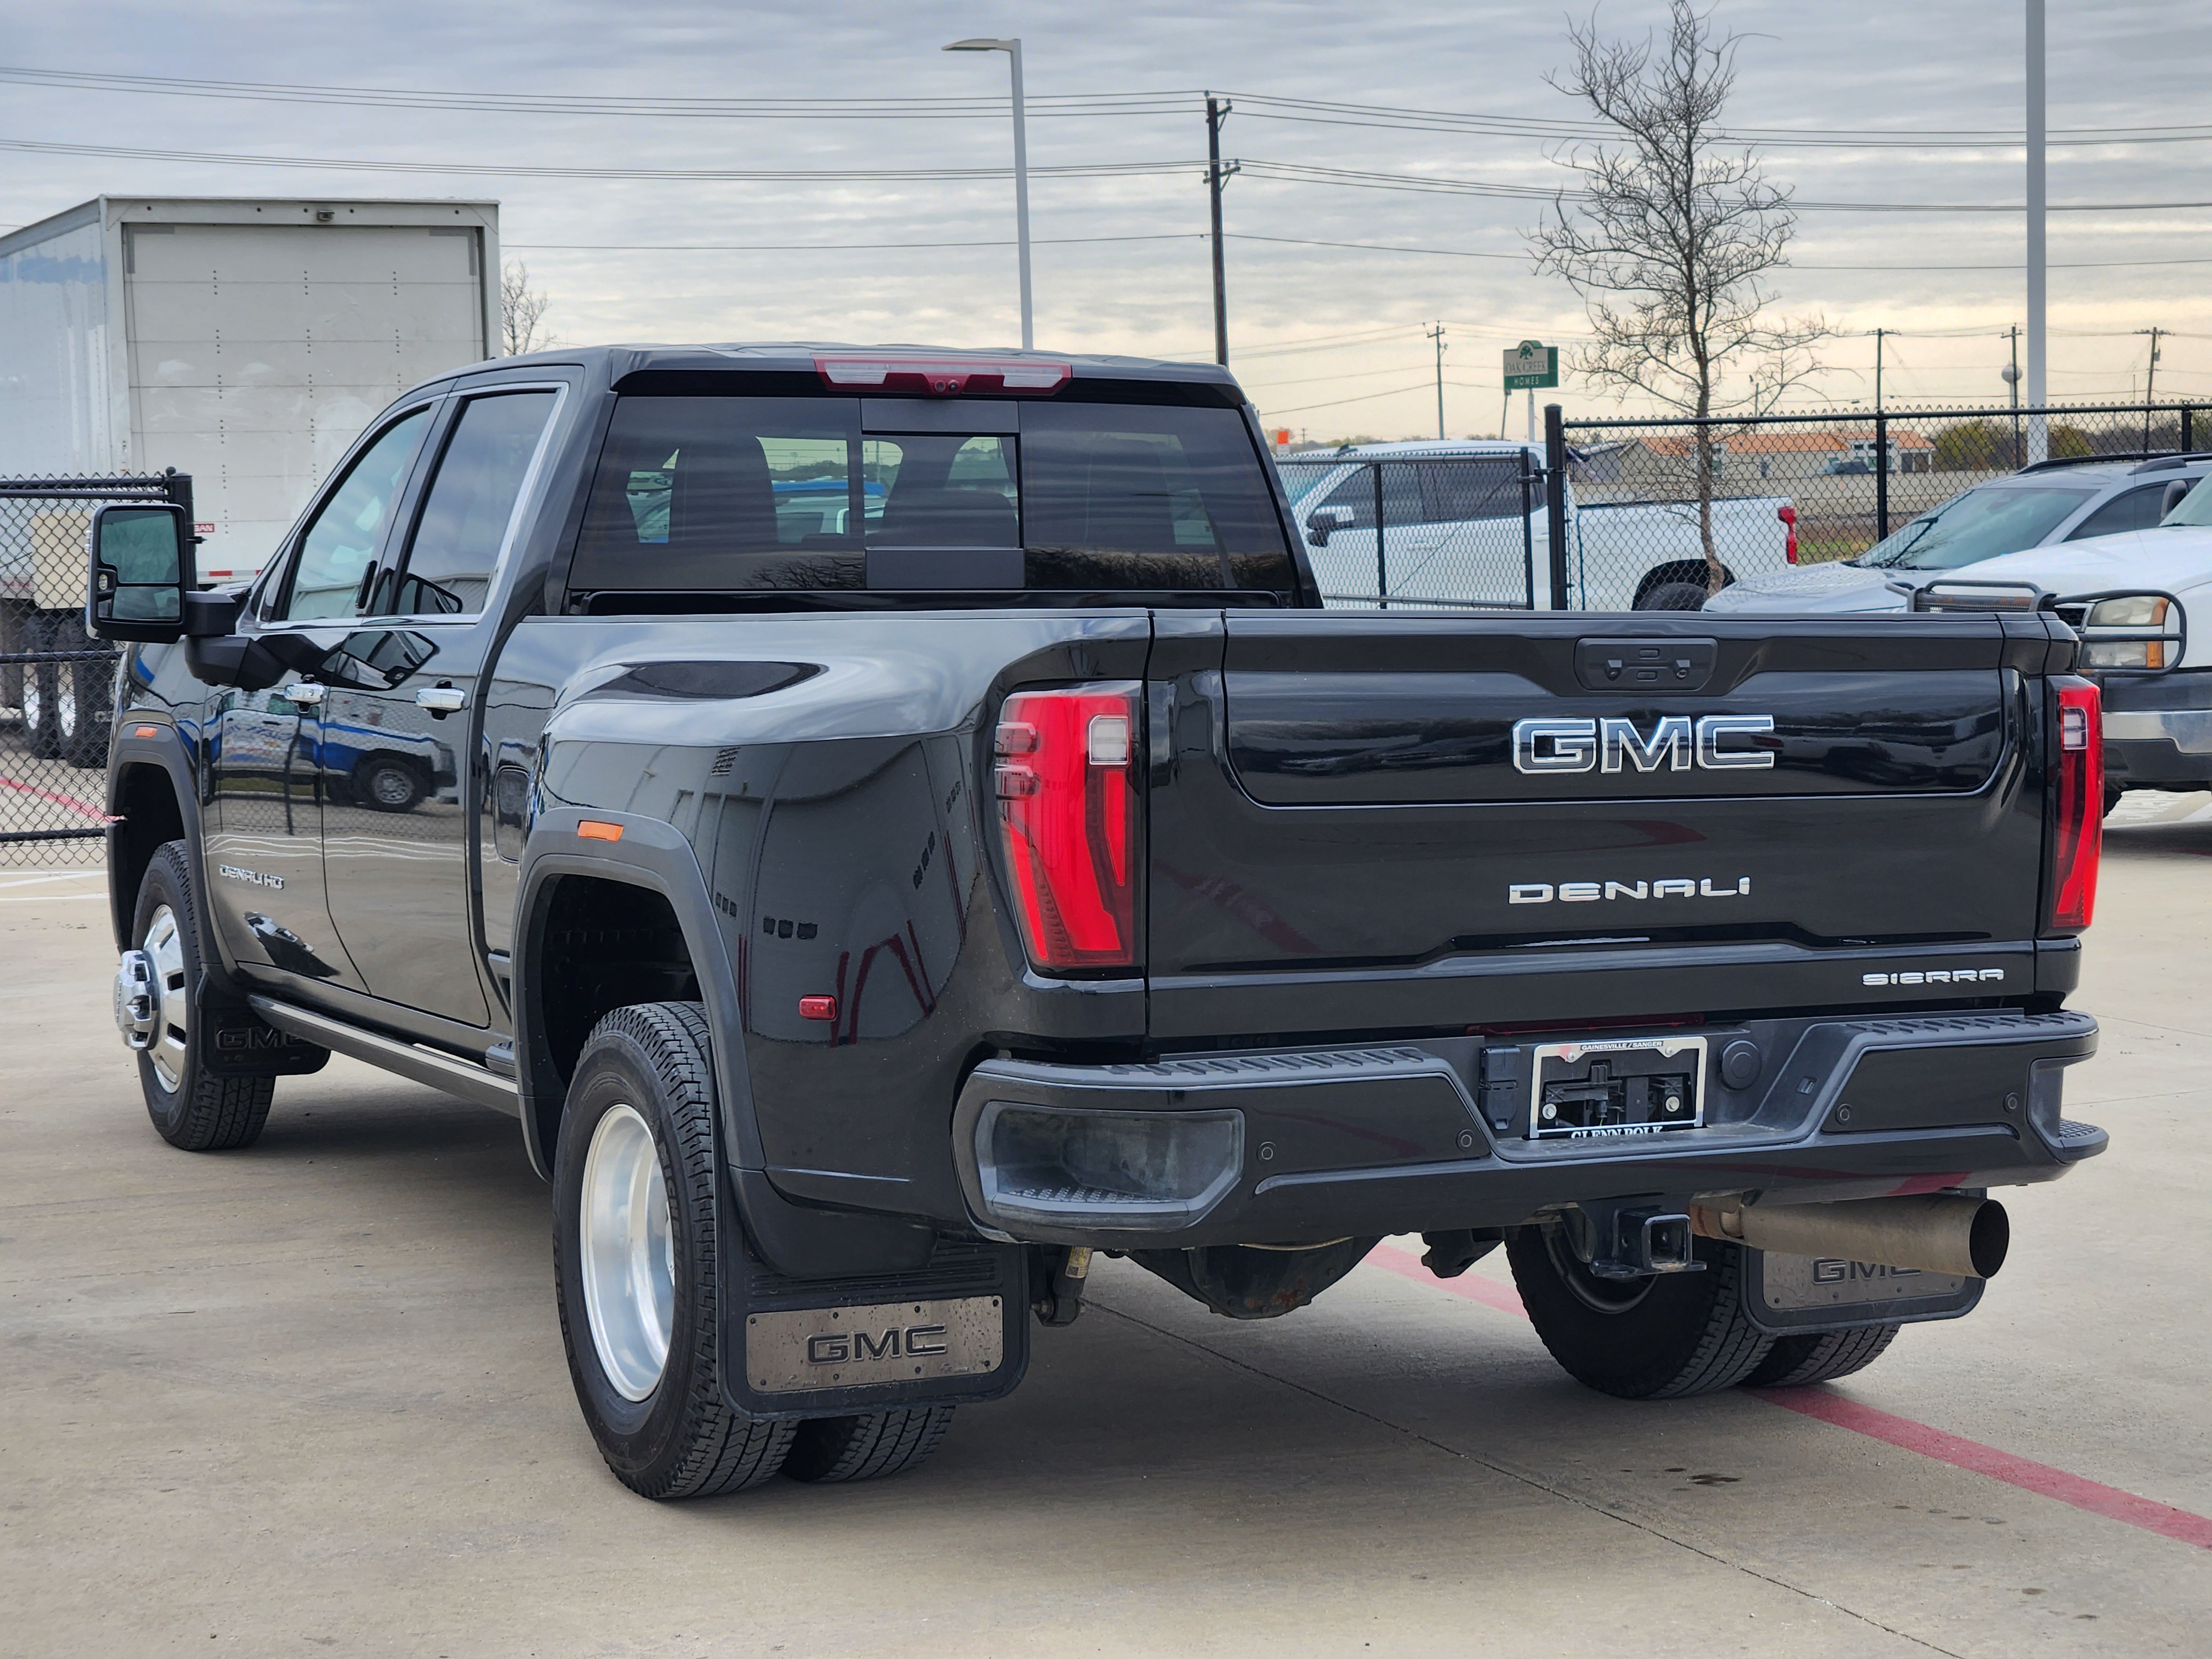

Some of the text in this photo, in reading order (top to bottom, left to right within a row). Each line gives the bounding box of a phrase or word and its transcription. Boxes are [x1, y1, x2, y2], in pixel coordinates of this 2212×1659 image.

[1506, 361, 1547, 374] OAK CREEK
[1514, 376, 1539, 385] HOMES
[1511, 714, 1775, 775] GMC
[220, 864, 285, 890] DENALI HD
[1509, 877, 1750, 904] DENALI
[1862, 968, 2005, 986] SIERRA
[806, 1323, 947, 1364] GMC
